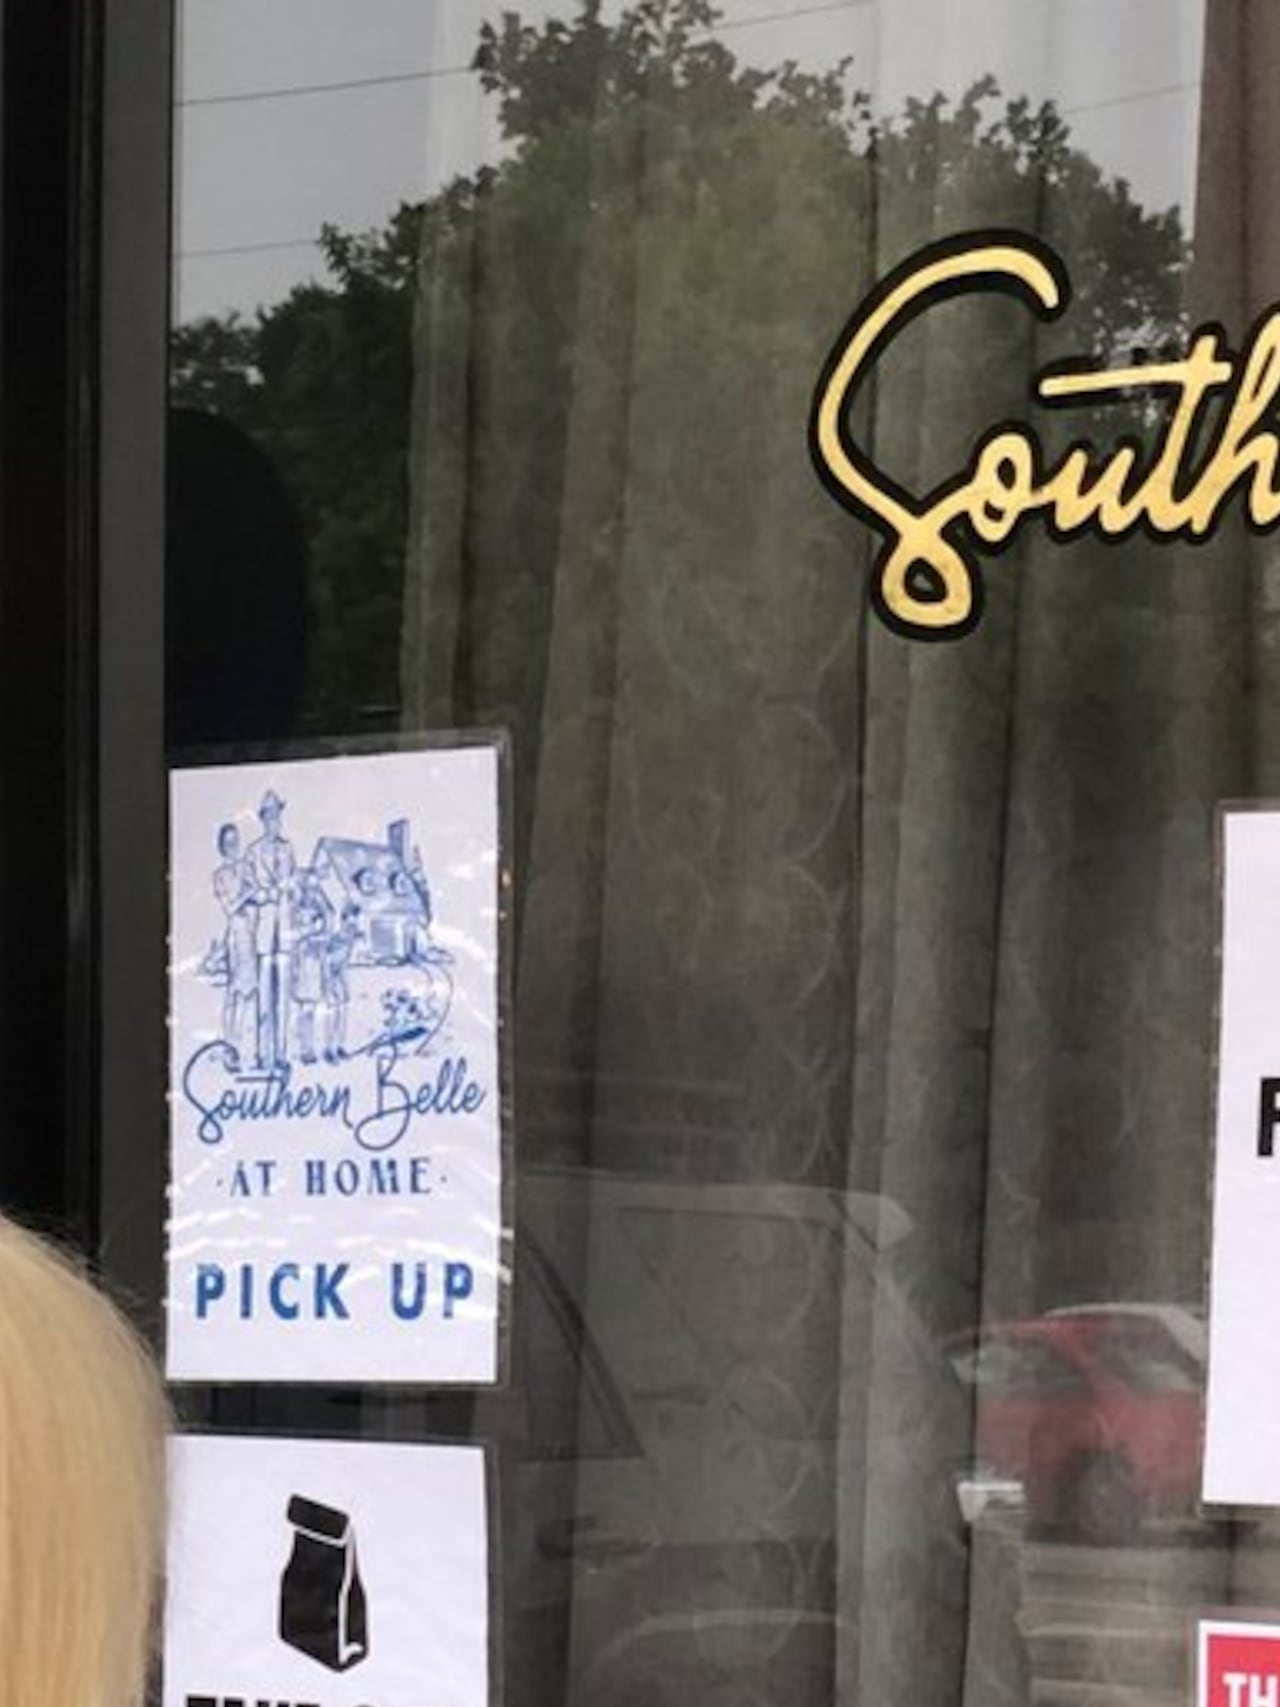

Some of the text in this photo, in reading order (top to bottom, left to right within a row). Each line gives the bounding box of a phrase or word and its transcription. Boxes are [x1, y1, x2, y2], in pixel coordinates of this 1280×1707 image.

[181, 1039, 486, 1152] Southern Belle
[230, 1156, 433, 1198] AT HOME
[193, 1260, 476, 1323] PICK UP
